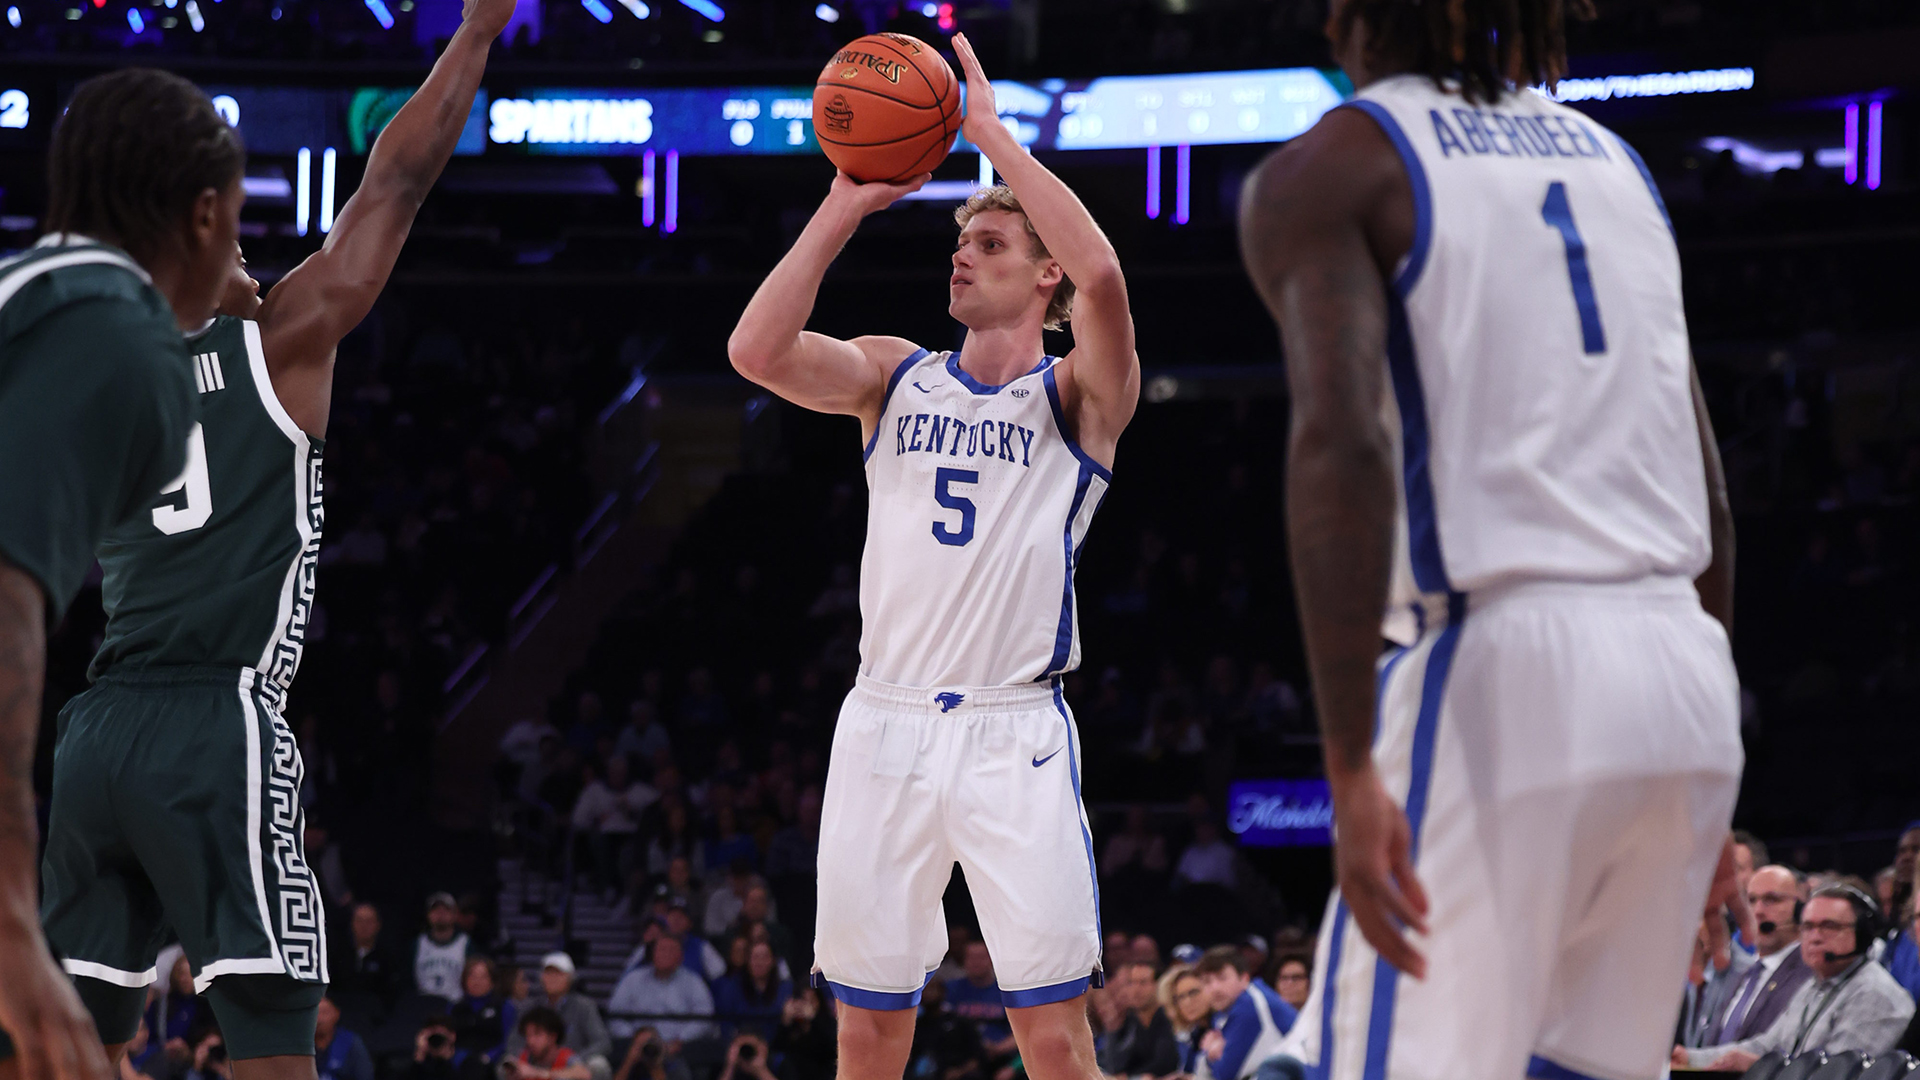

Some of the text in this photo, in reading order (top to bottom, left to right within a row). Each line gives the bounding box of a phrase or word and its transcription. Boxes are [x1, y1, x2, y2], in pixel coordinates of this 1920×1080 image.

[0, 89, 29, 129] 2
[489, 98, 653, 144] SPARTANS
[786, 120, 806, 146] 1
[1541, 182, 1608, 356] 1
[897, 414, 1034, 468] KENTUCKY
[932, 467, 979, 547] 5
